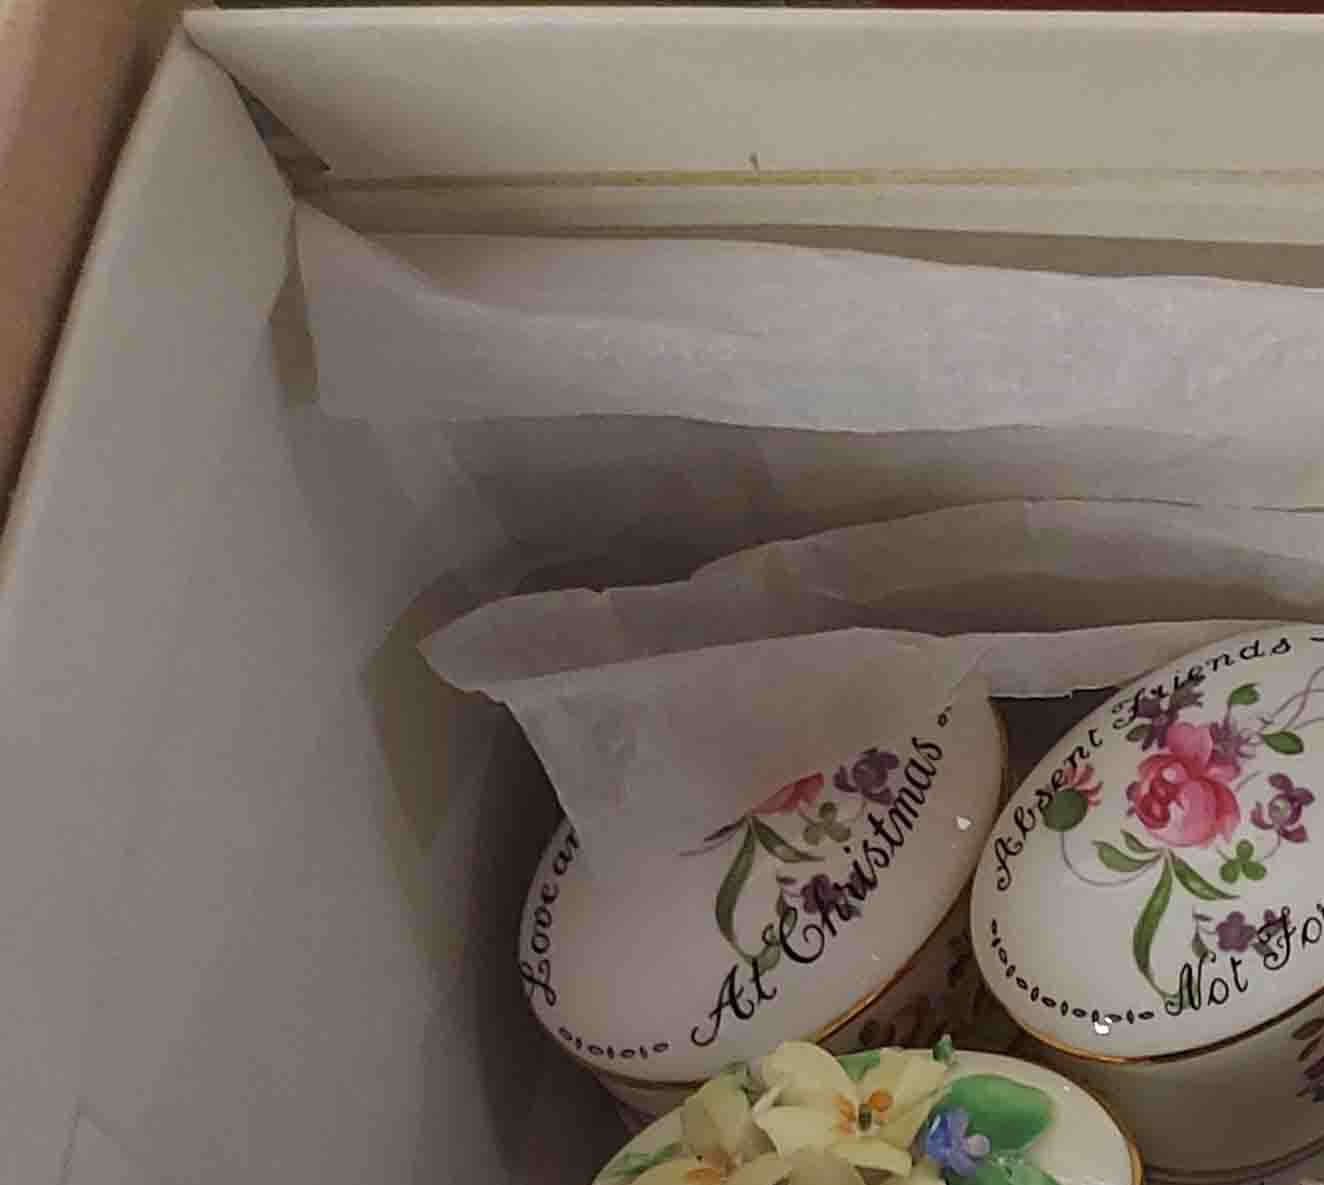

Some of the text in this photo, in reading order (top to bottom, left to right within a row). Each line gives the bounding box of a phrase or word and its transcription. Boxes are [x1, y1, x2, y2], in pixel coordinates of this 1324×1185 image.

[995, 636, 1293, 891] Absent Friends
[519, 879, 560, 1007] Love
[690, 737, 944, 1047] At Christmas
[1163, 952, 1250, 1017] Not
